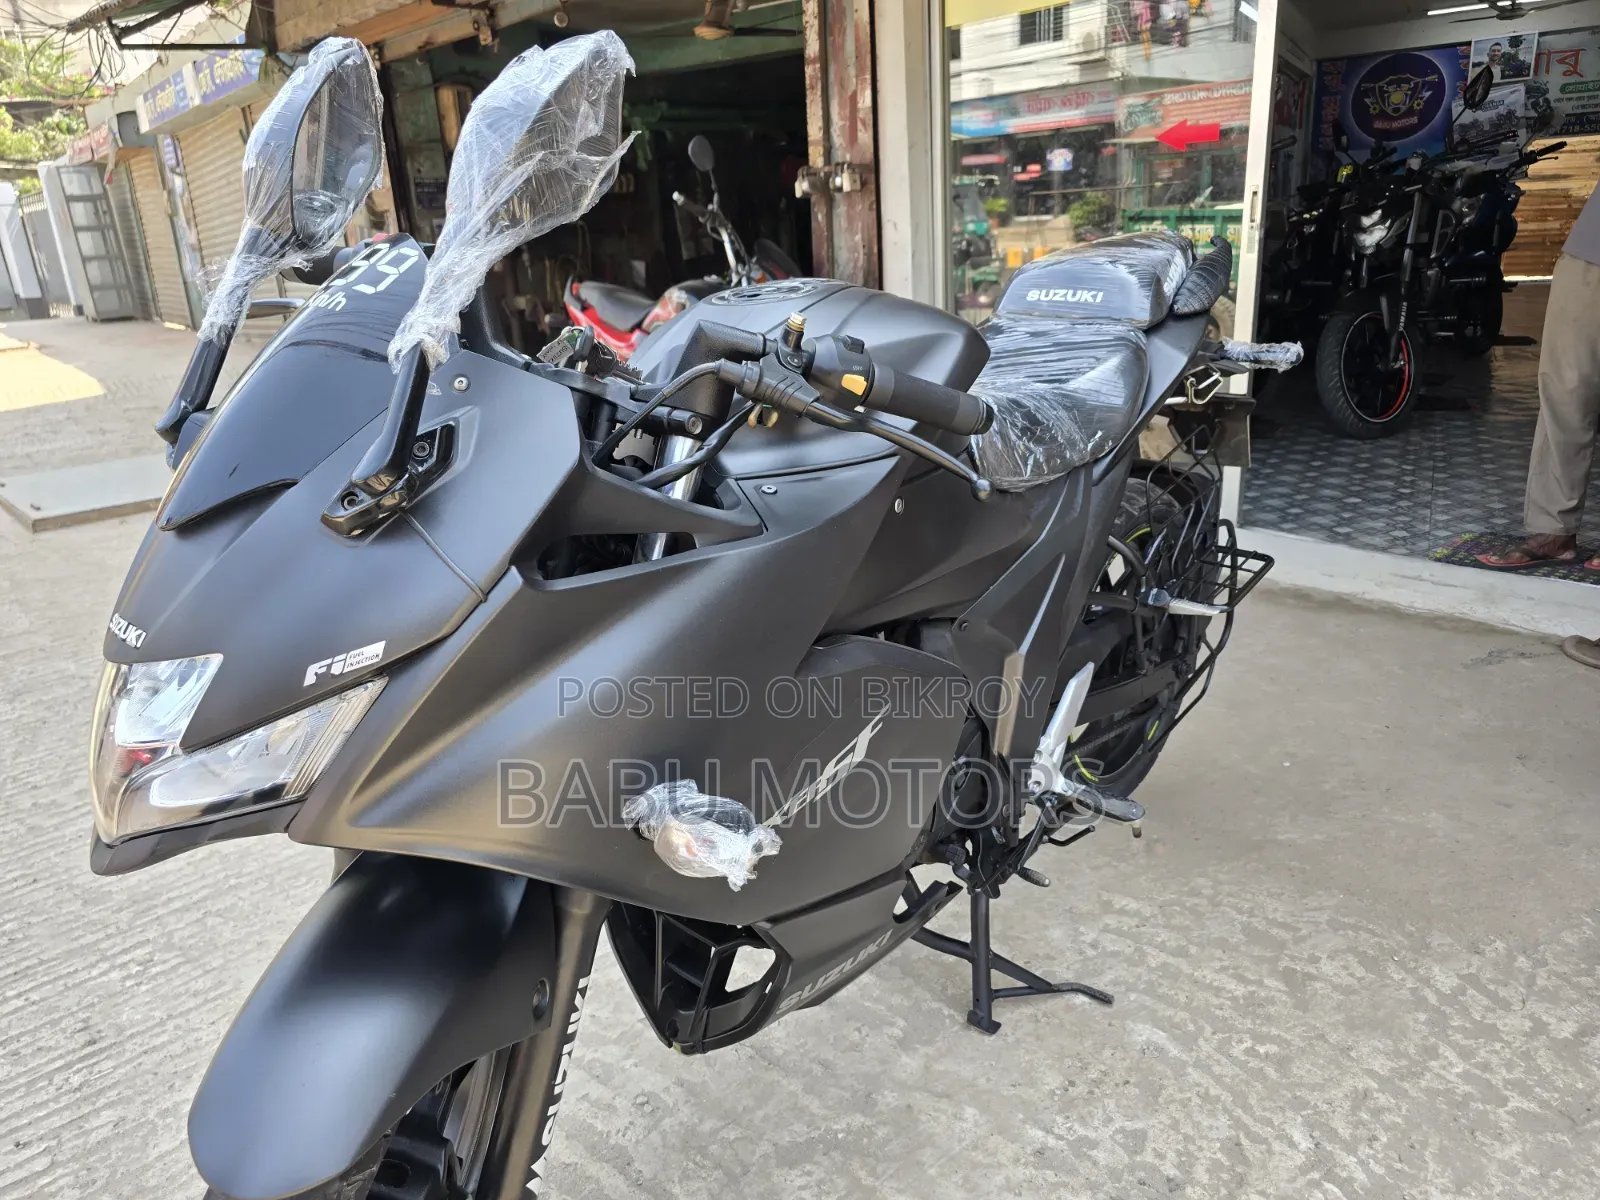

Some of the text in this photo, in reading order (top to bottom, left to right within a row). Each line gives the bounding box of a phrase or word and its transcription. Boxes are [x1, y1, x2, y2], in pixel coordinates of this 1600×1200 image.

[1391, 116, 1418, 129] MOTORS
[1026, 289, 1104, 303] SUZUKI
[1398, 301, 1408, 331] YAMAHA
[109, 612, 147, 648] SUZUKI
[346, 653, 380, 669] INJECTION
[349, 650, 364, 660] FUEL
[776, 929, 893, 1015] SUZUKI
